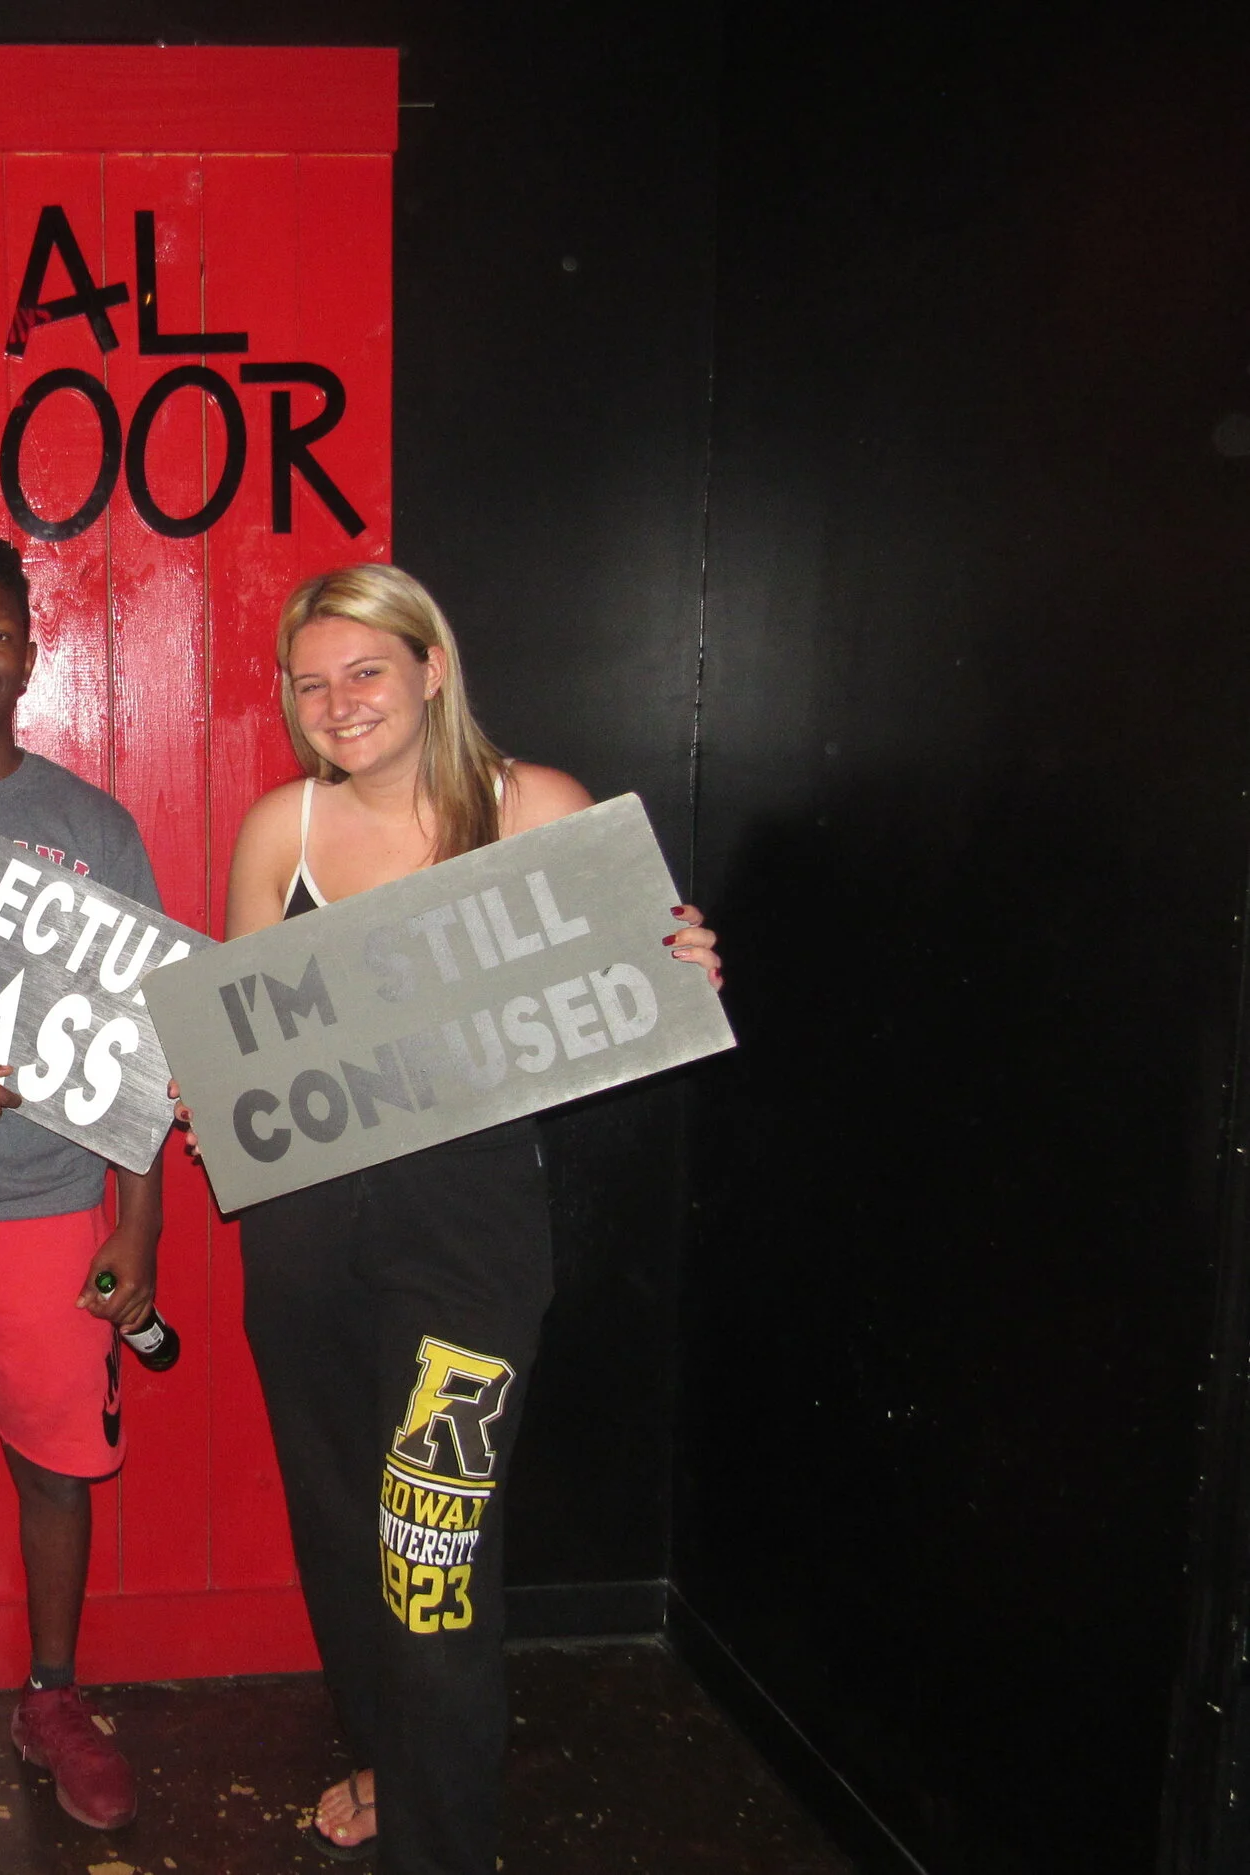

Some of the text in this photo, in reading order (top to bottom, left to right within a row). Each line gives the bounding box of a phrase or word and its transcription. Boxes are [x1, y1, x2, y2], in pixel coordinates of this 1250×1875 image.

[218, 871, 590, 1056] I'M STILL
[232, 962, 658, 1163] CONFUSED
[391, 1335, 517, 1478] R
[379, 1502, 480, 1566] UNIVERSITY
[380, 1470, 490, 1531] ROWAN
[379, 1537, 472, 1634] 1923
